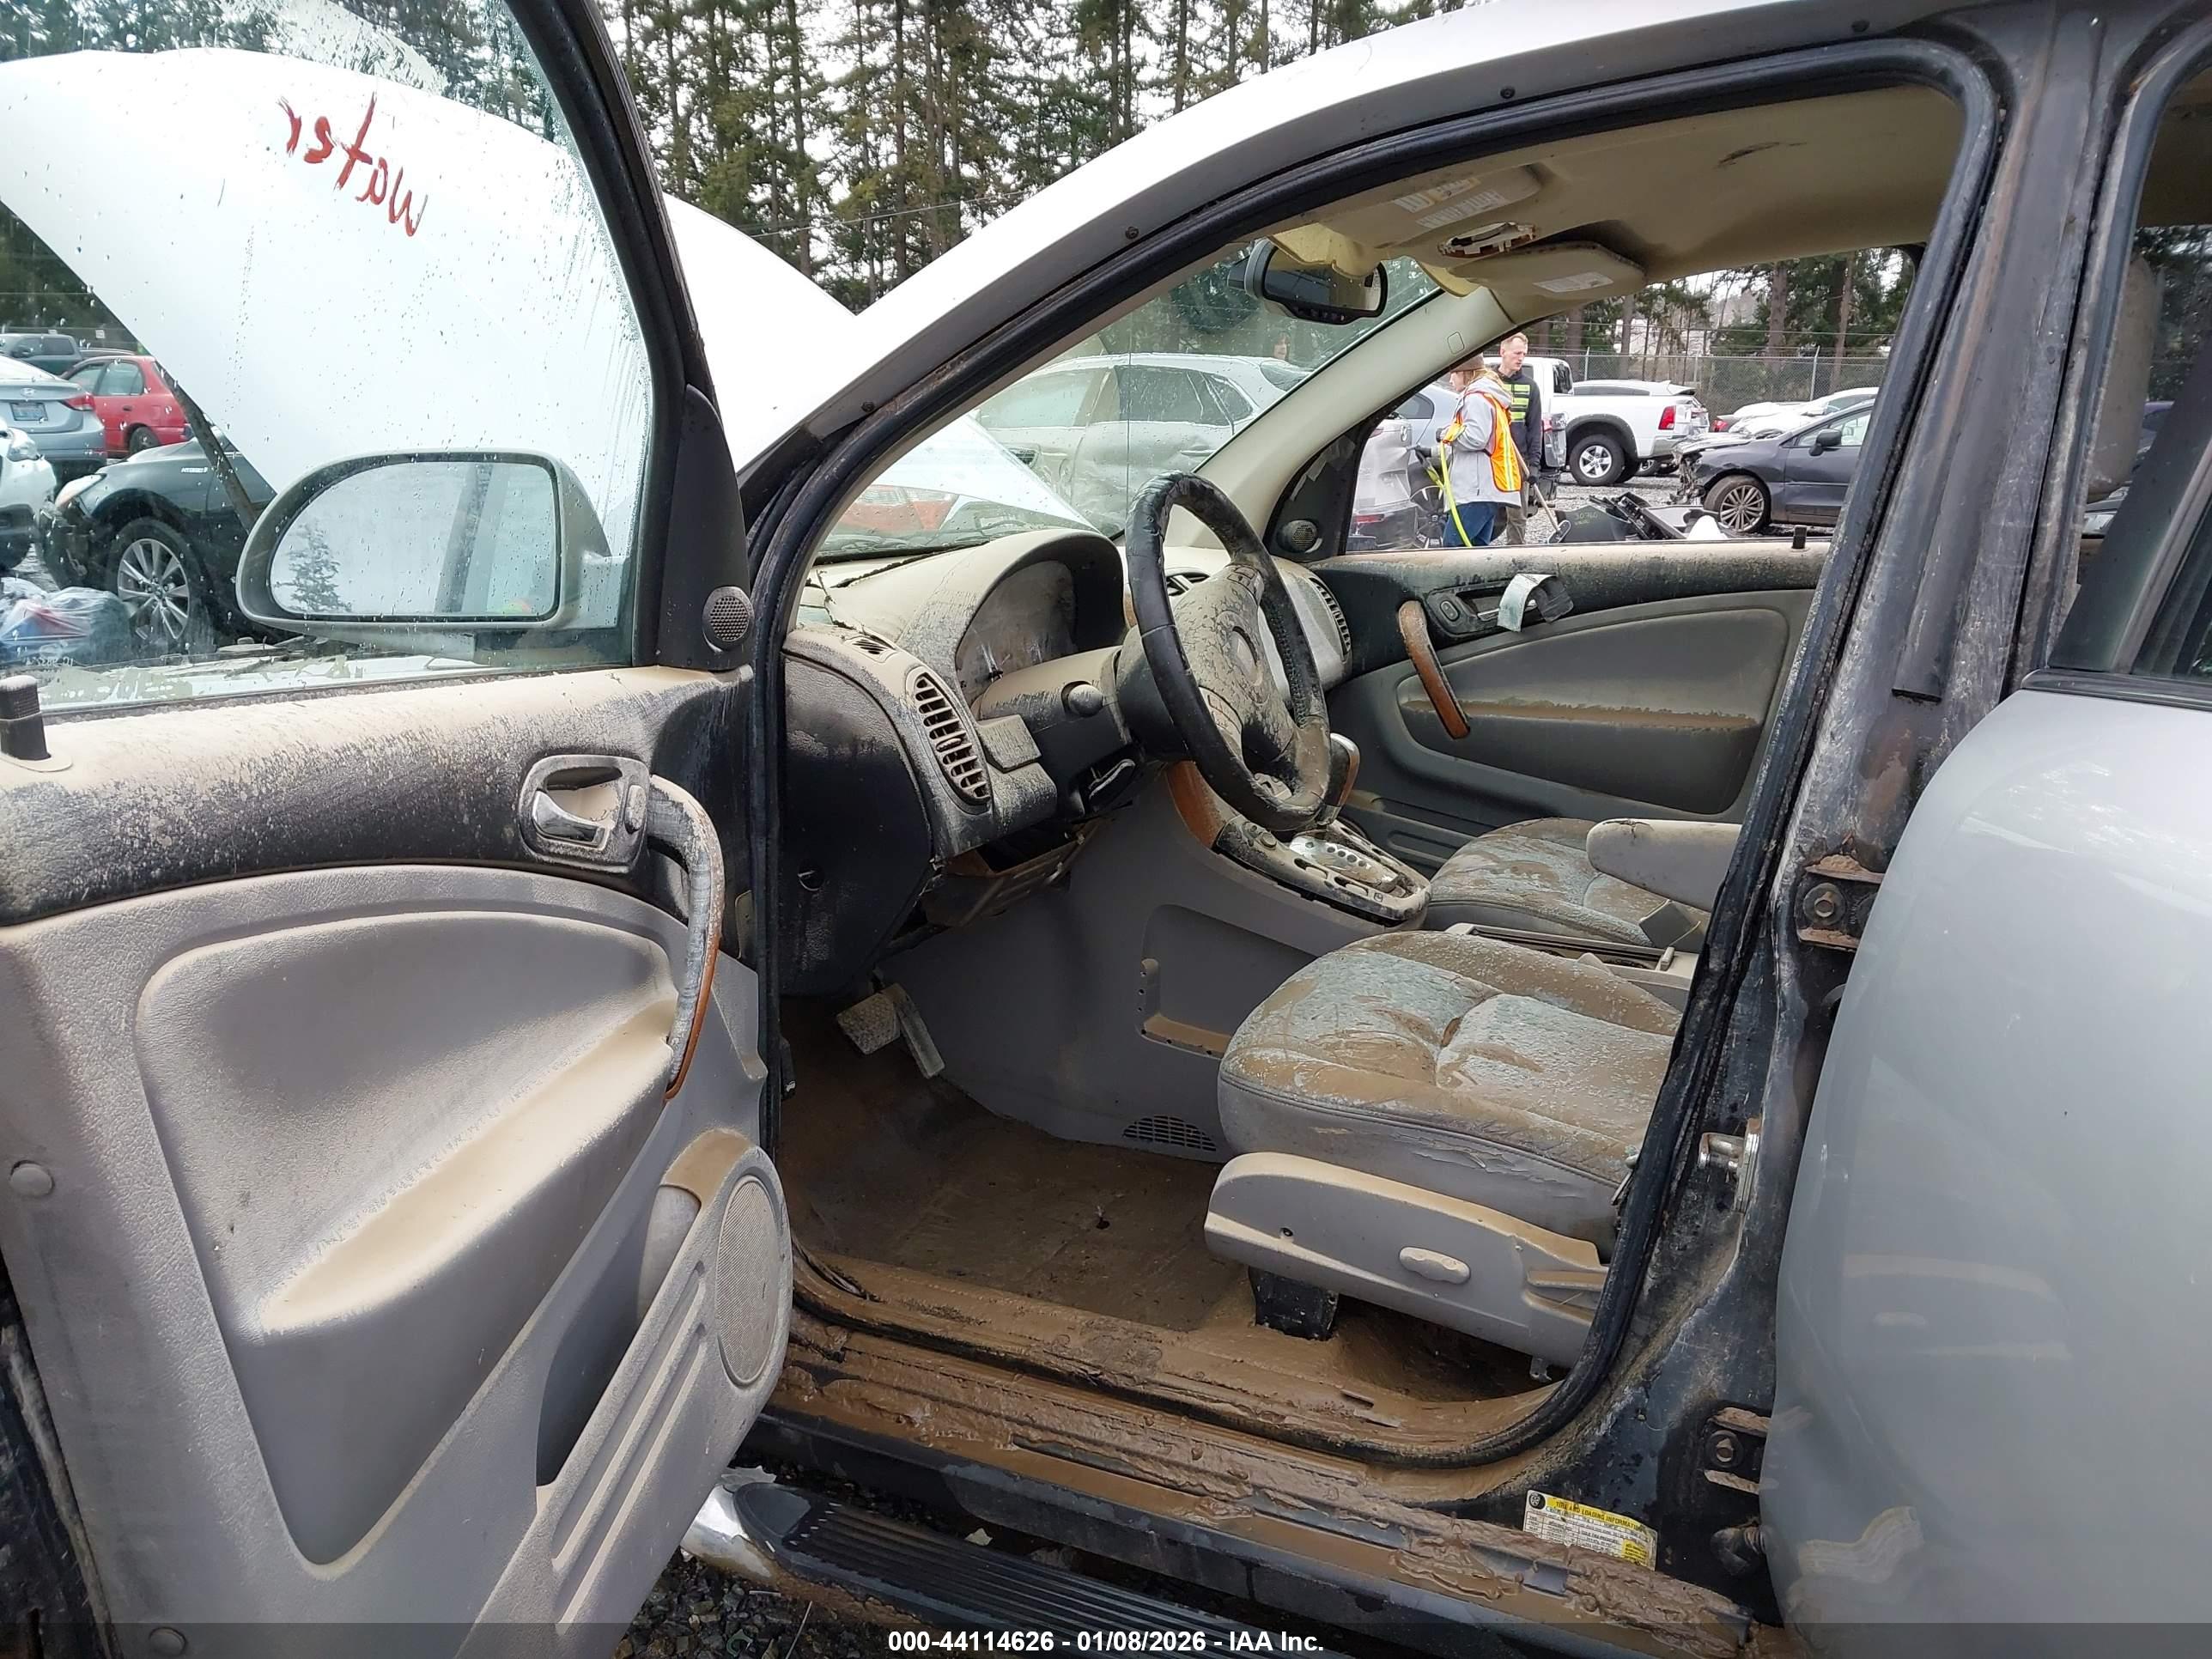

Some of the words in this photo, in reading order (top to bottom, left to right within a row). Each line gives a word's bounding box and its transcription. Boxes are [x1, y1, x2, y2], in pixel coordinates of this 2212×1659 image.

[1556, 1501, 1567, 1510] TIRE
[1569, 1504, 1581, 1513] AND
[1582, 1509, 1605, 1520] LOADING
